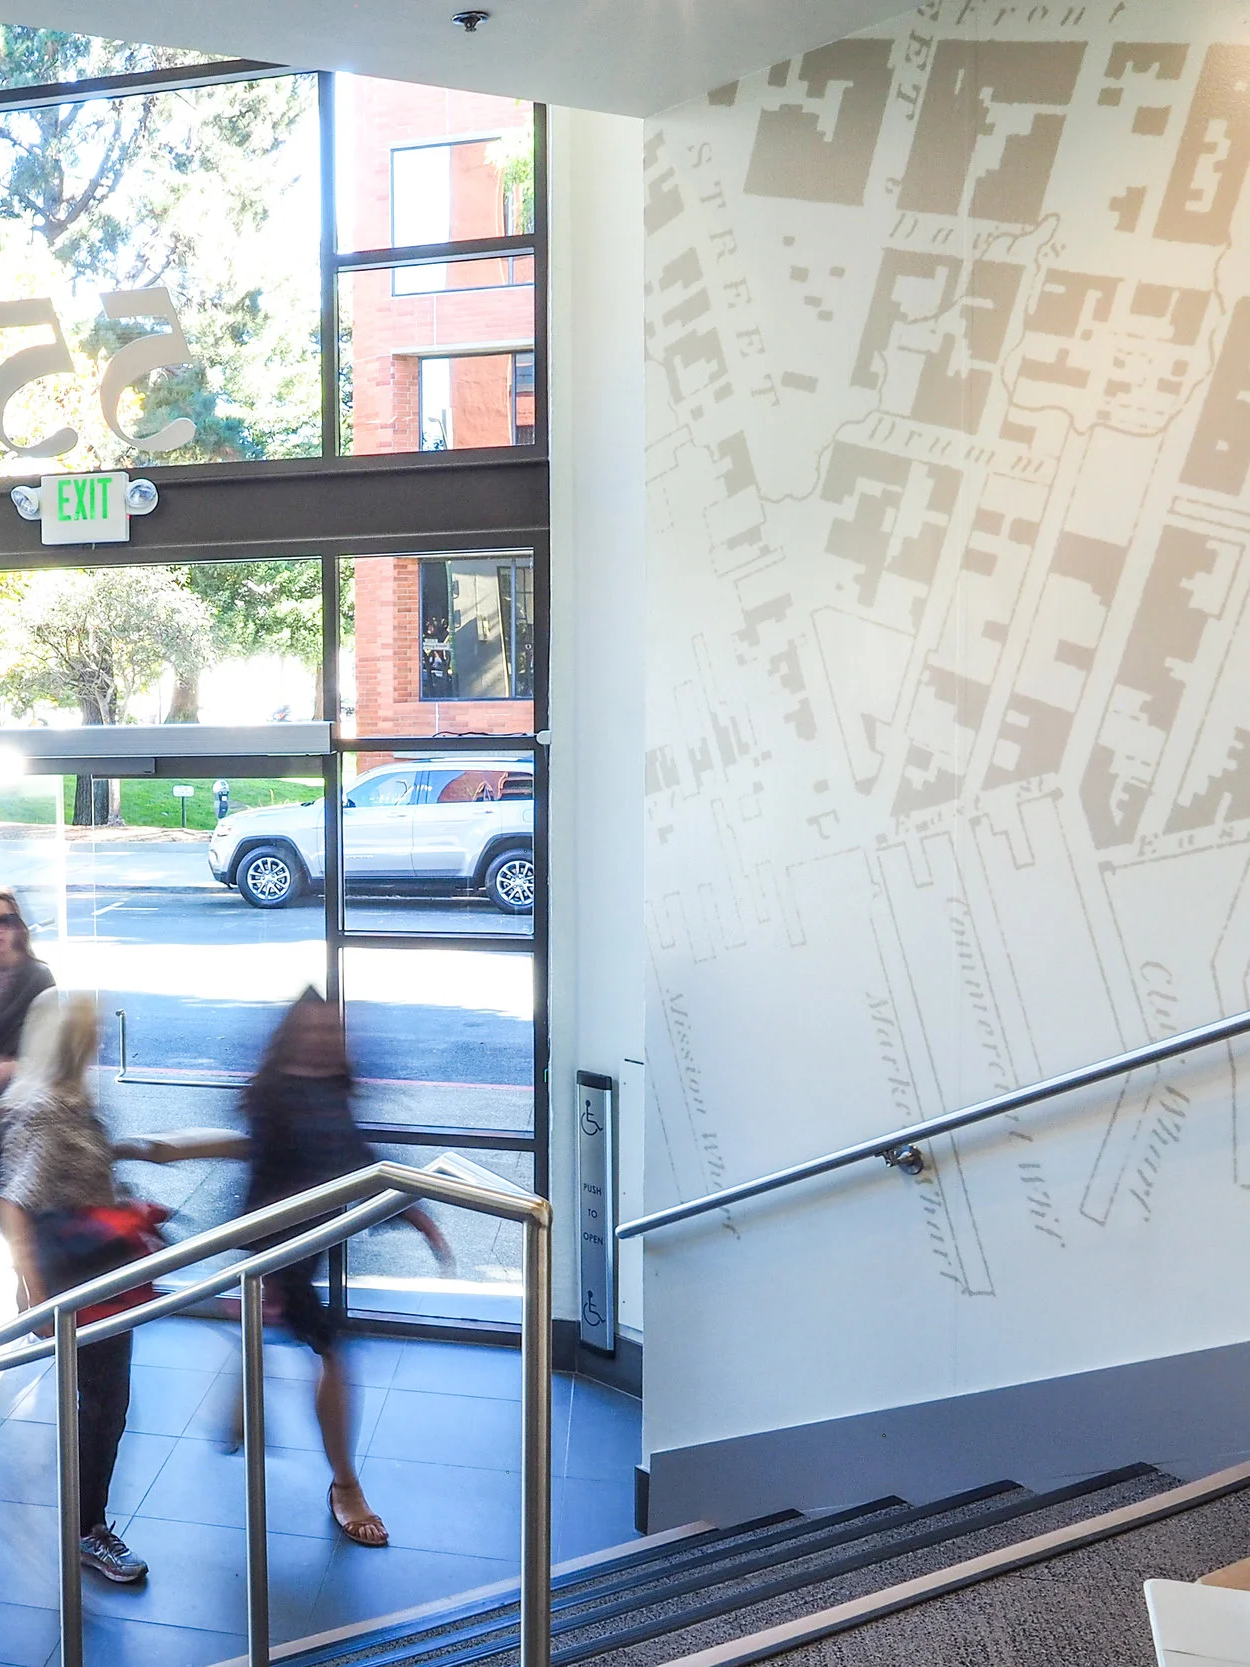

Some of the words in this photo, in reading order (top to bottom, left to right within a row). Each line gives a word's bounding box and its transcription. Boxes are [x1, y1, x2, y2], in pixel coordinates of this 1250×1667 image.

[688, 141, 781, 408] STREET
[57, 477, 112, 522] EXIT
[946, 895, 1034, 1143] Commercil
[1140, 961, 1186, 1064] Cla
[865, 991, 913, 1129] Marke
[583, 1183, 602, 1196] PUSH
[587, 1208, 598, 1219] TO
[583, 1232, 603, 1245] OPEN
